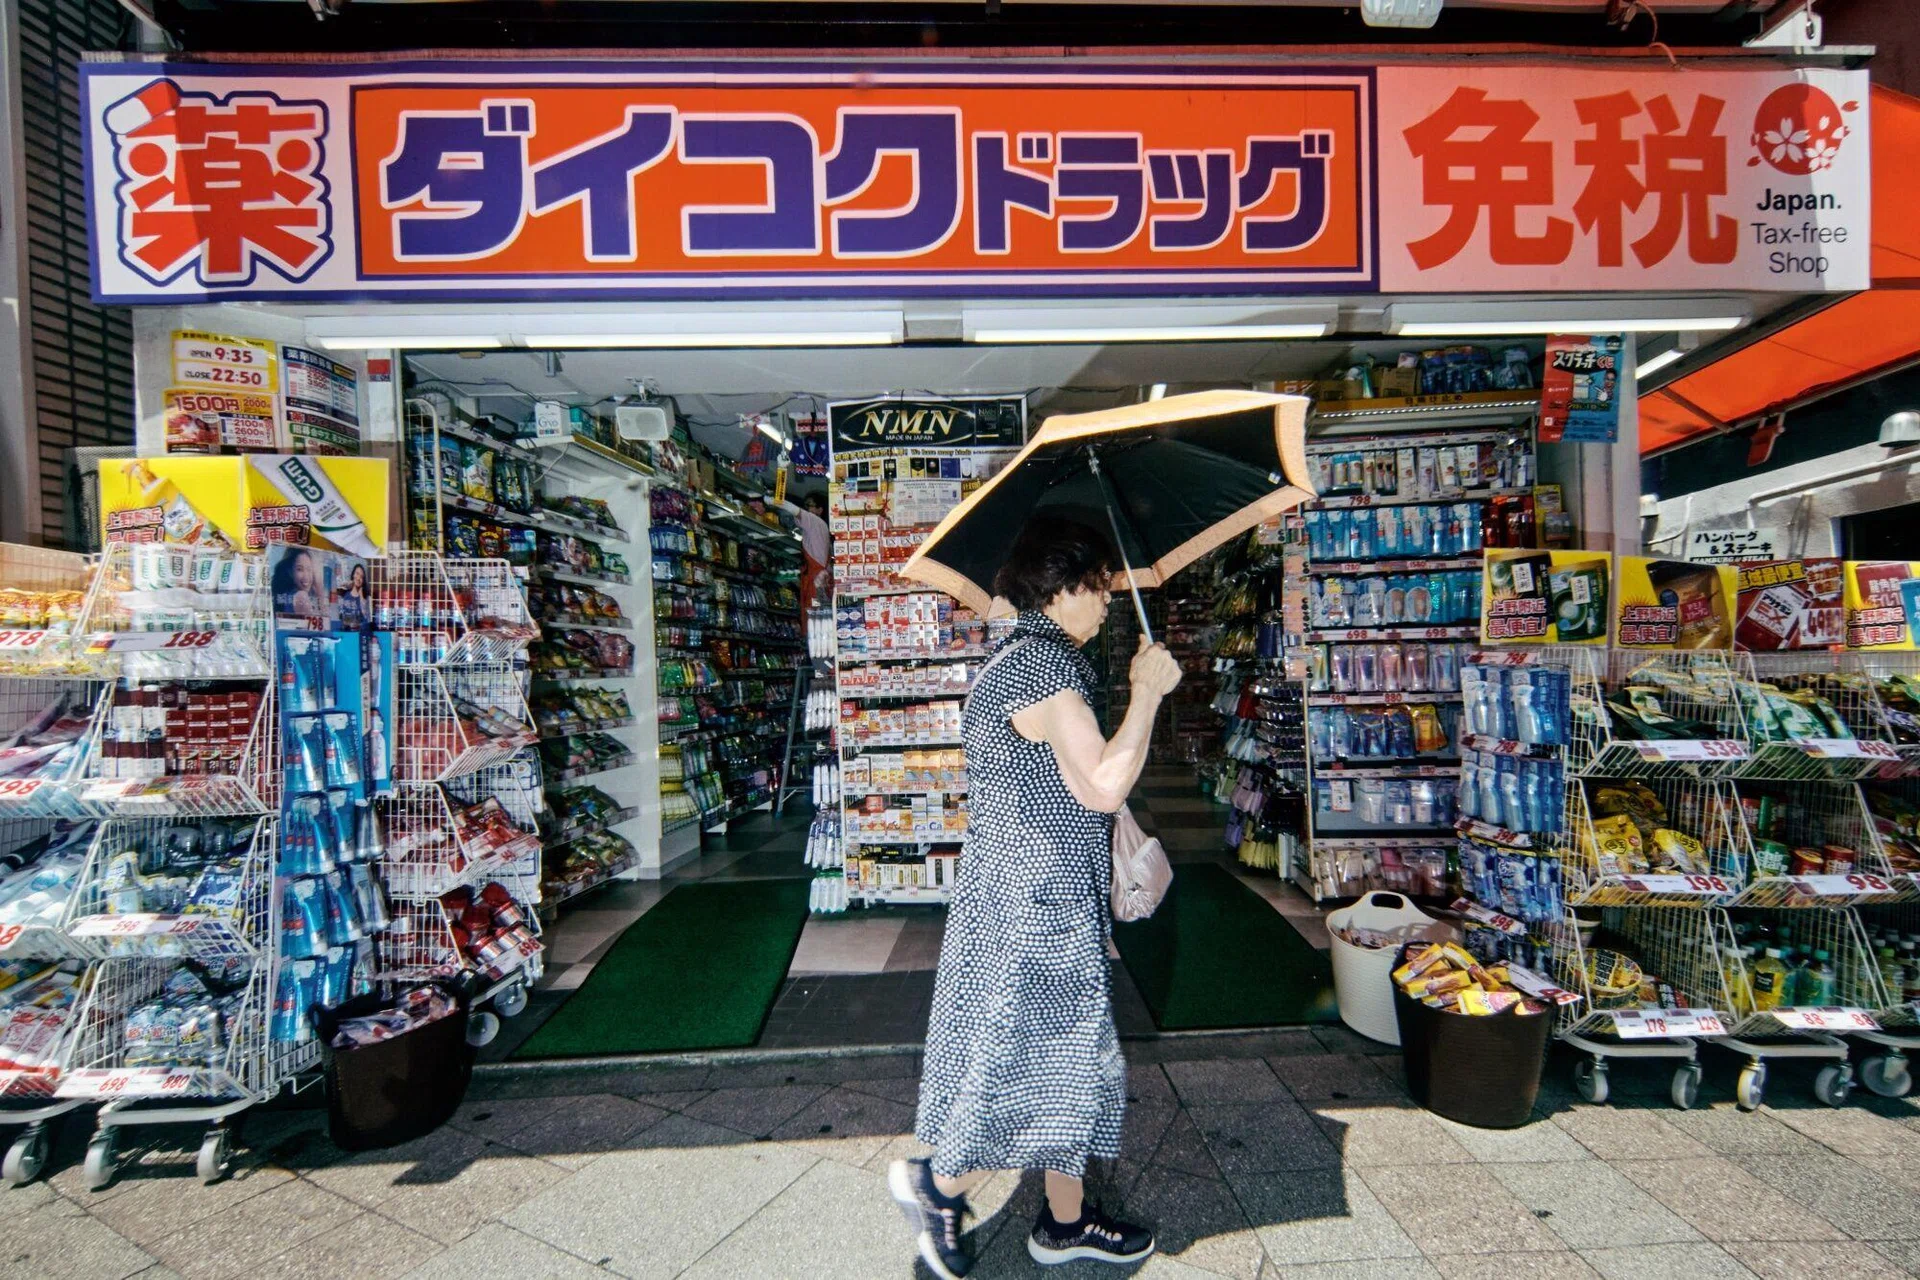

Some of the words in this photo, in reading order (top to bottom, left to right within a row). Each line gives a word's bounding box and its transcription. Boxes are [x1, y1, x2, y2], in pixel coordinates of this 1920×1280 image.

[107, 82, 322, 276] 薬
[382, 101, 1333, 260] ダイコクドラッグ
[1402, 86, 1738, 270] 免税
[1757, 188, 1842, 214] Japan.
[1751, 222, 1848, 245] Tax-free
[1768, 252, 1829, 277] Shop
[191, 349, 212, 358] OPEN
[214, 347, 253, 363] 9:35
[185, 368, 211, 379] CLOSE
[212, 368, 262, 385] 22:50
[859, 410, 958, 437] NMN
[284, 459, 321, 501] GUM
[247, 506, 310, 527] 上野附近
[1695, 530, 1758, 543] ハンバーグ
[1710, 545, 1720, 555] &
[1722, 542, 1772, 554] ステーキ
[1489, 598, 1547, 616] 上野附近
[1620, 606, 1677, 623] 上野附近
[1848, 606, 1905, 626] 上野附近
[1346, 630, 1368, 640] 698
[1426, 628, 1448, 638] 698
[1488, 616, 1547, 639] 最便宜!
[1620, 624, 1677, 644] 最便宜!
[1848, 624, 1906, 647] 最便宜!
[164, 630, 217, 648] 188
[1699, 741, 1739, 757] 538
[0, 780, 42, 794] 98
[1683, 876, 1729, 892] 198
[1845, 874, 1889, 890] 98
[169, 920, 201, 933] 128
[1645, 1018, 1667, 1033] 178
[1696, 1016, 1720, 1031] 128
[100, 1077, 128, 1091] 698
[162, 1075, 191, 1089] 880
